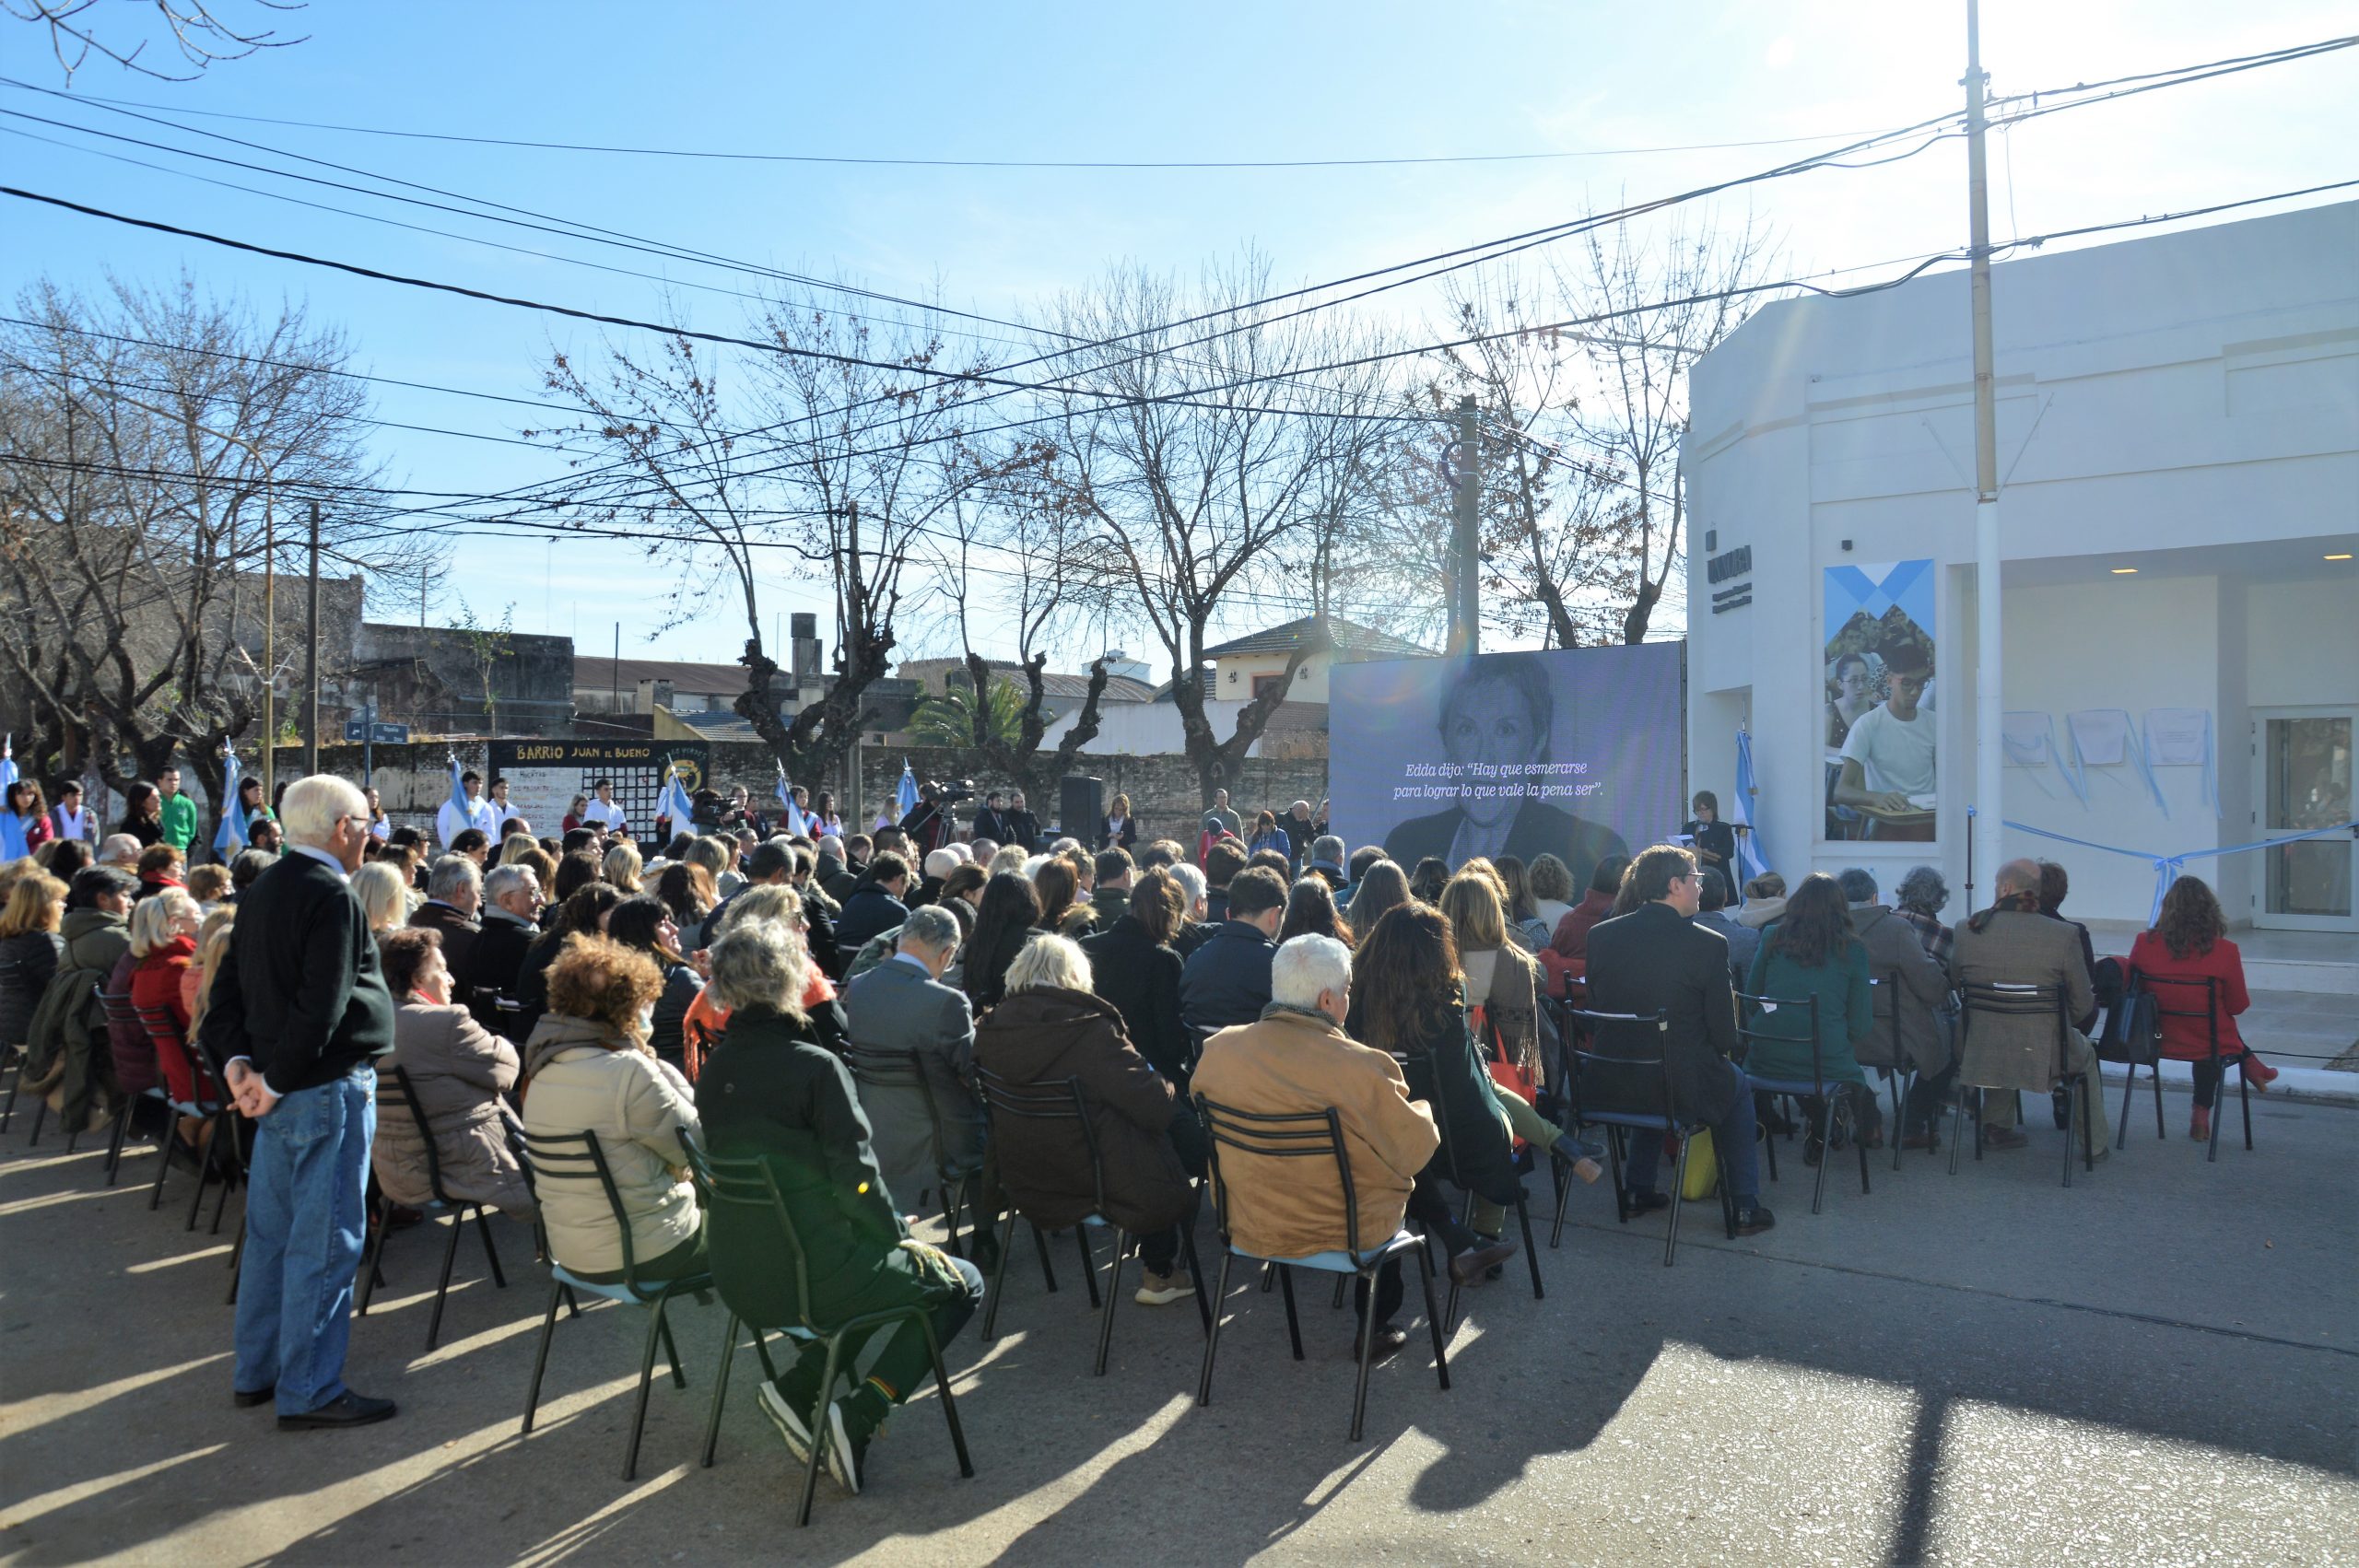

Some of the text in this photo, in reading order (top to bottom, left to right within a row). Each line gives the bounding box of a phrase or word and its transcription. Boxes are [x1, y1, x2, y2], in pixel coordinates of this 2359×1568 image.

[516, 744, 564, 760] BARRIO
[570, 747, 599, 757] JUAN
[615, 747, 651, 758] BUENO
[1405, 764, 1437, 777] Edda
[1438, 763, 1464, 778] dijo:
[1499, 764, 1522, 778] que
[1524, 763, 1588, 775] esmerarse
[1393, 786, 1422, 800] para
[1424, 784, 1460, 800] lograr
[1461, 784, 1473, 797] lo
[1474, 785, 1496, 800] que
[1498, 783, 1524, 797] vale
[1526, 783, 1539, 797] la
[1541, 784, 1574, 800] pena
